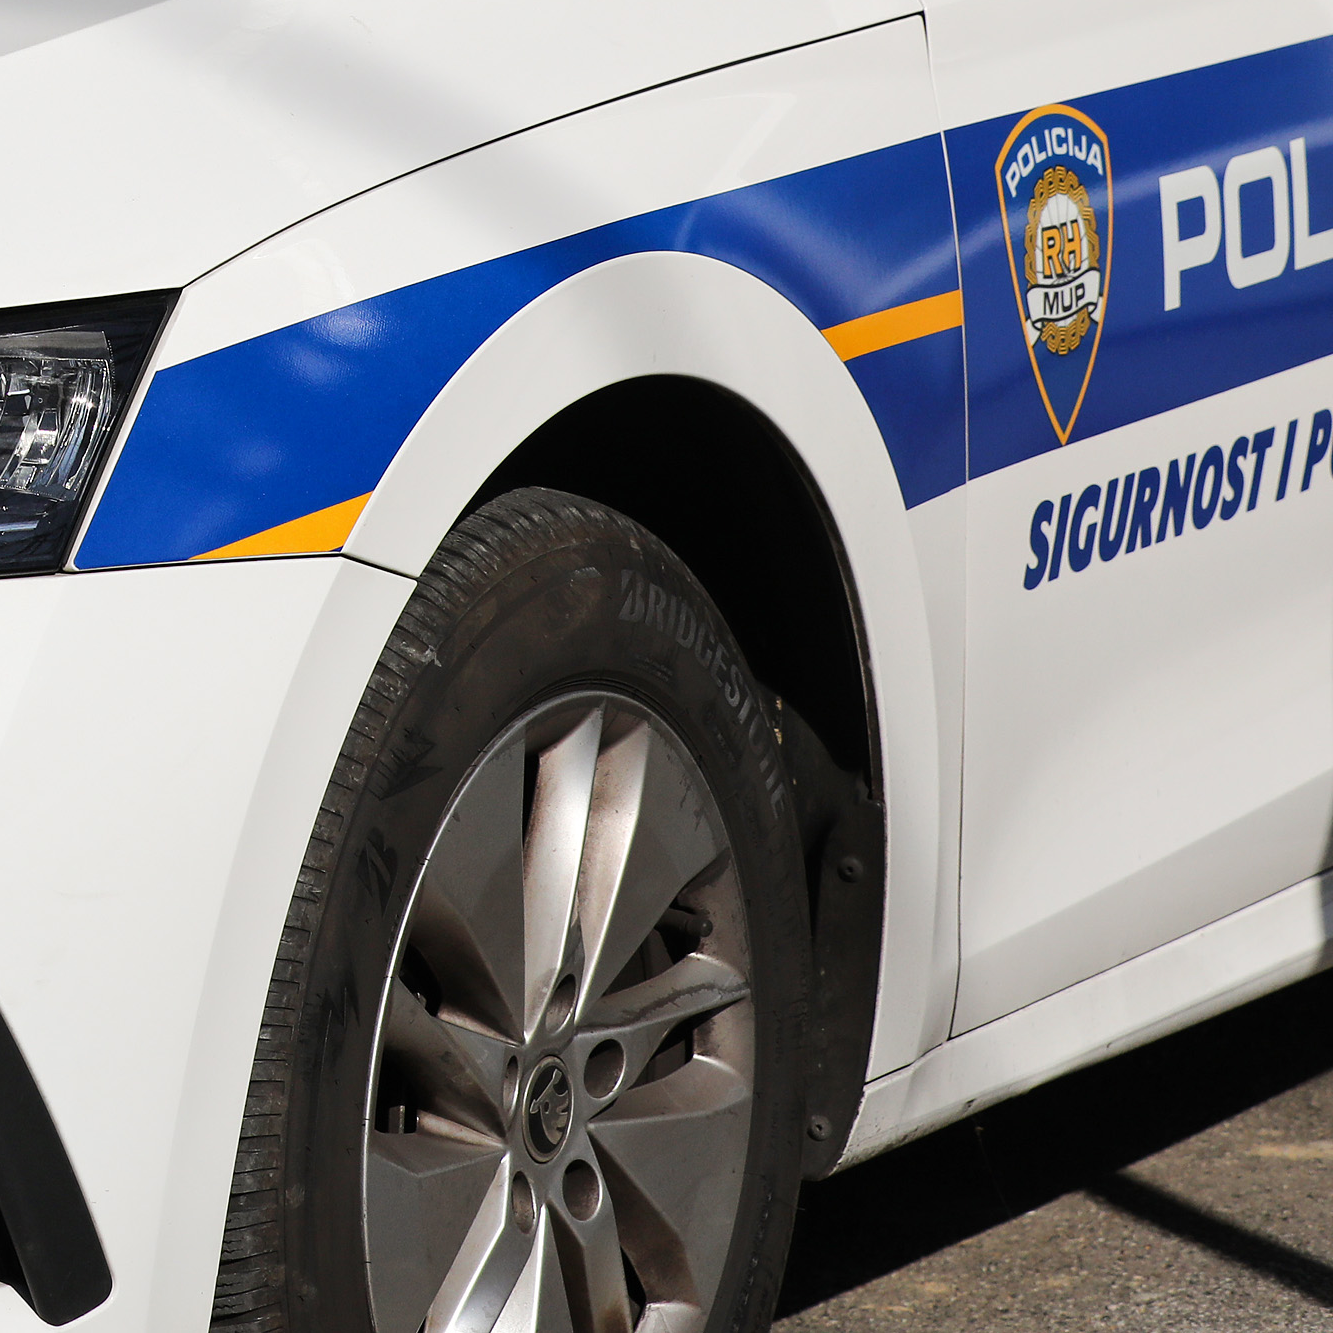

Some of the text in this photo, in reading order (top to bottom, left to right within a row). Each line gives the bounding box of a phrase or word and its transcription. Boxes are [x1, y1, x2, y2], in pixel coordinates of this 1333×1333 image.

[1005, 127, 1104, 198] POLICIJA
[1041, 219, 1083, 280] RH
[1158, 136, 1333, 312] POL
[1043, 282, 1086, 316] MUP
[1024, 408, 1333, 590] SIGURNOST I P
